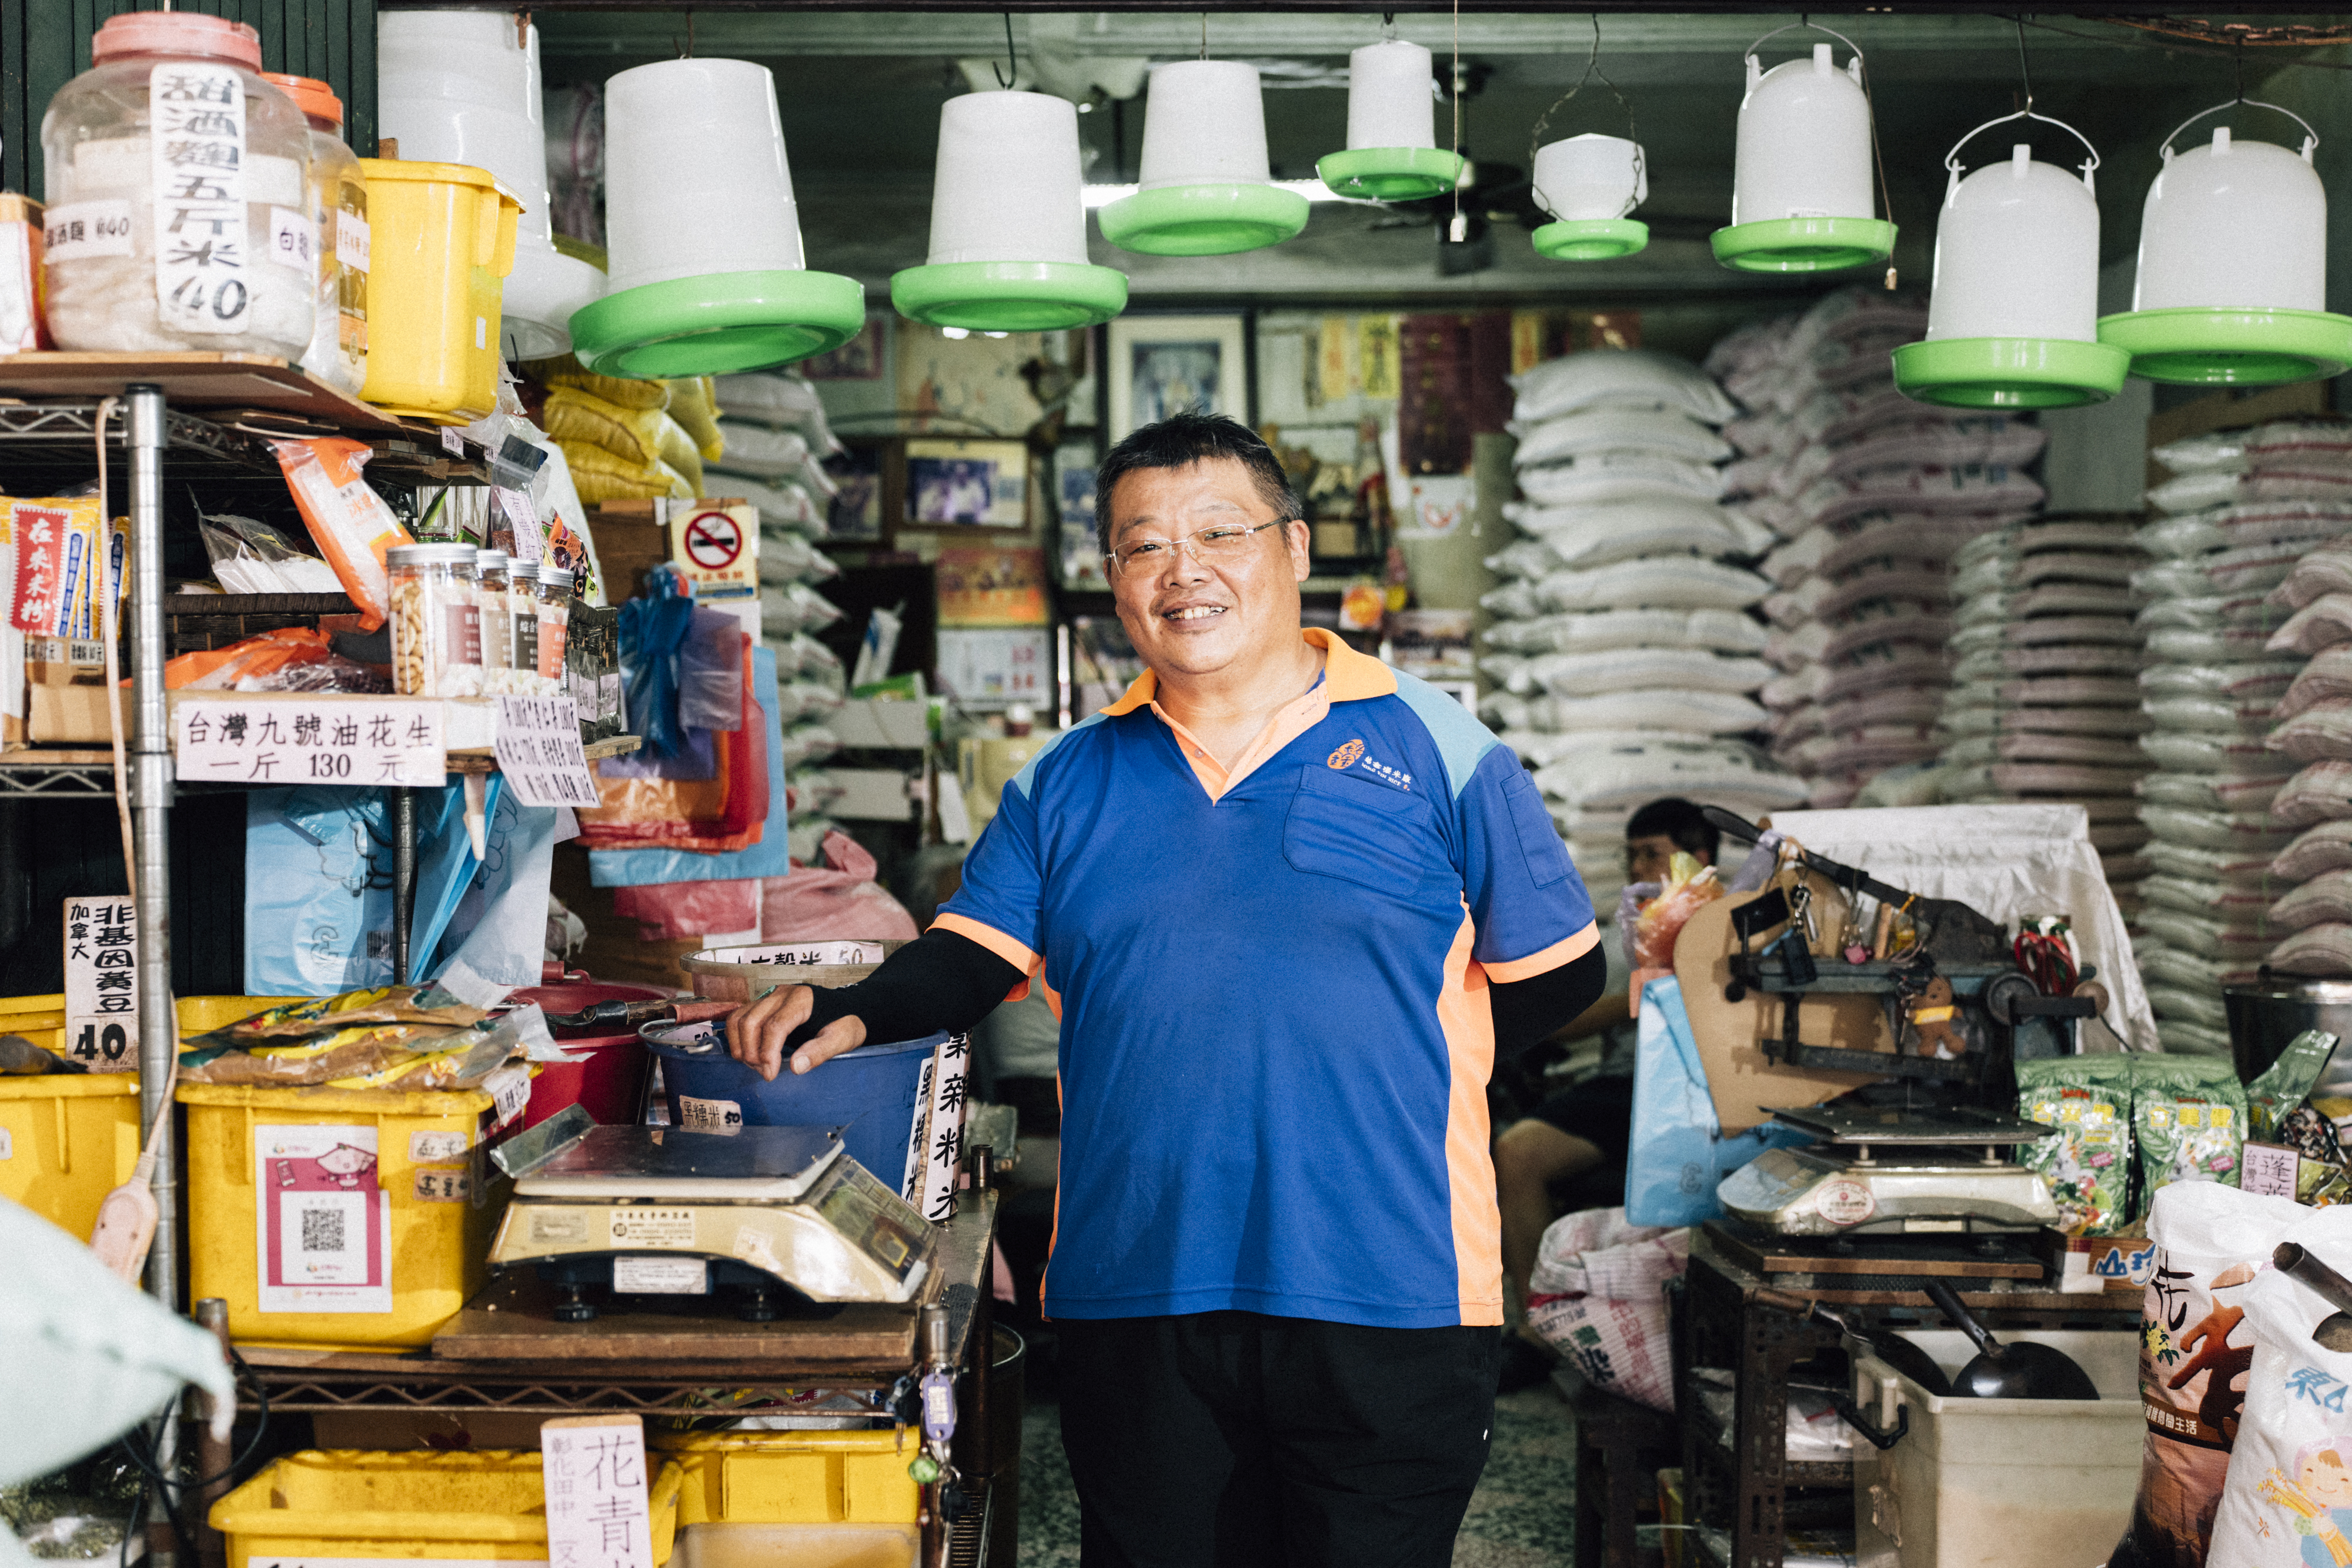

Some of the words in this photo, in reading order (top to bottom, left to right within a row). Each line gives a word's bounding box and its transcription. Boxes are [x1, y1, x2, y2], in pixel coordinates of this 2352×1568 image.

[188, 711, 433, 748] 台灣九號油花生
[209, 752, 280, 780] 一斤
[309, 754, 351, 777] 130
[376, 754, 406, 782] 元
[70, 903, 90, 959] 加拿大
[93, 904, 136, 1013] 非基因黃豆
[74, 1023, 126, 1061] 40
[724, 1111, 740, 1124] 50
[584, 1435, 643, 1568] 花青
